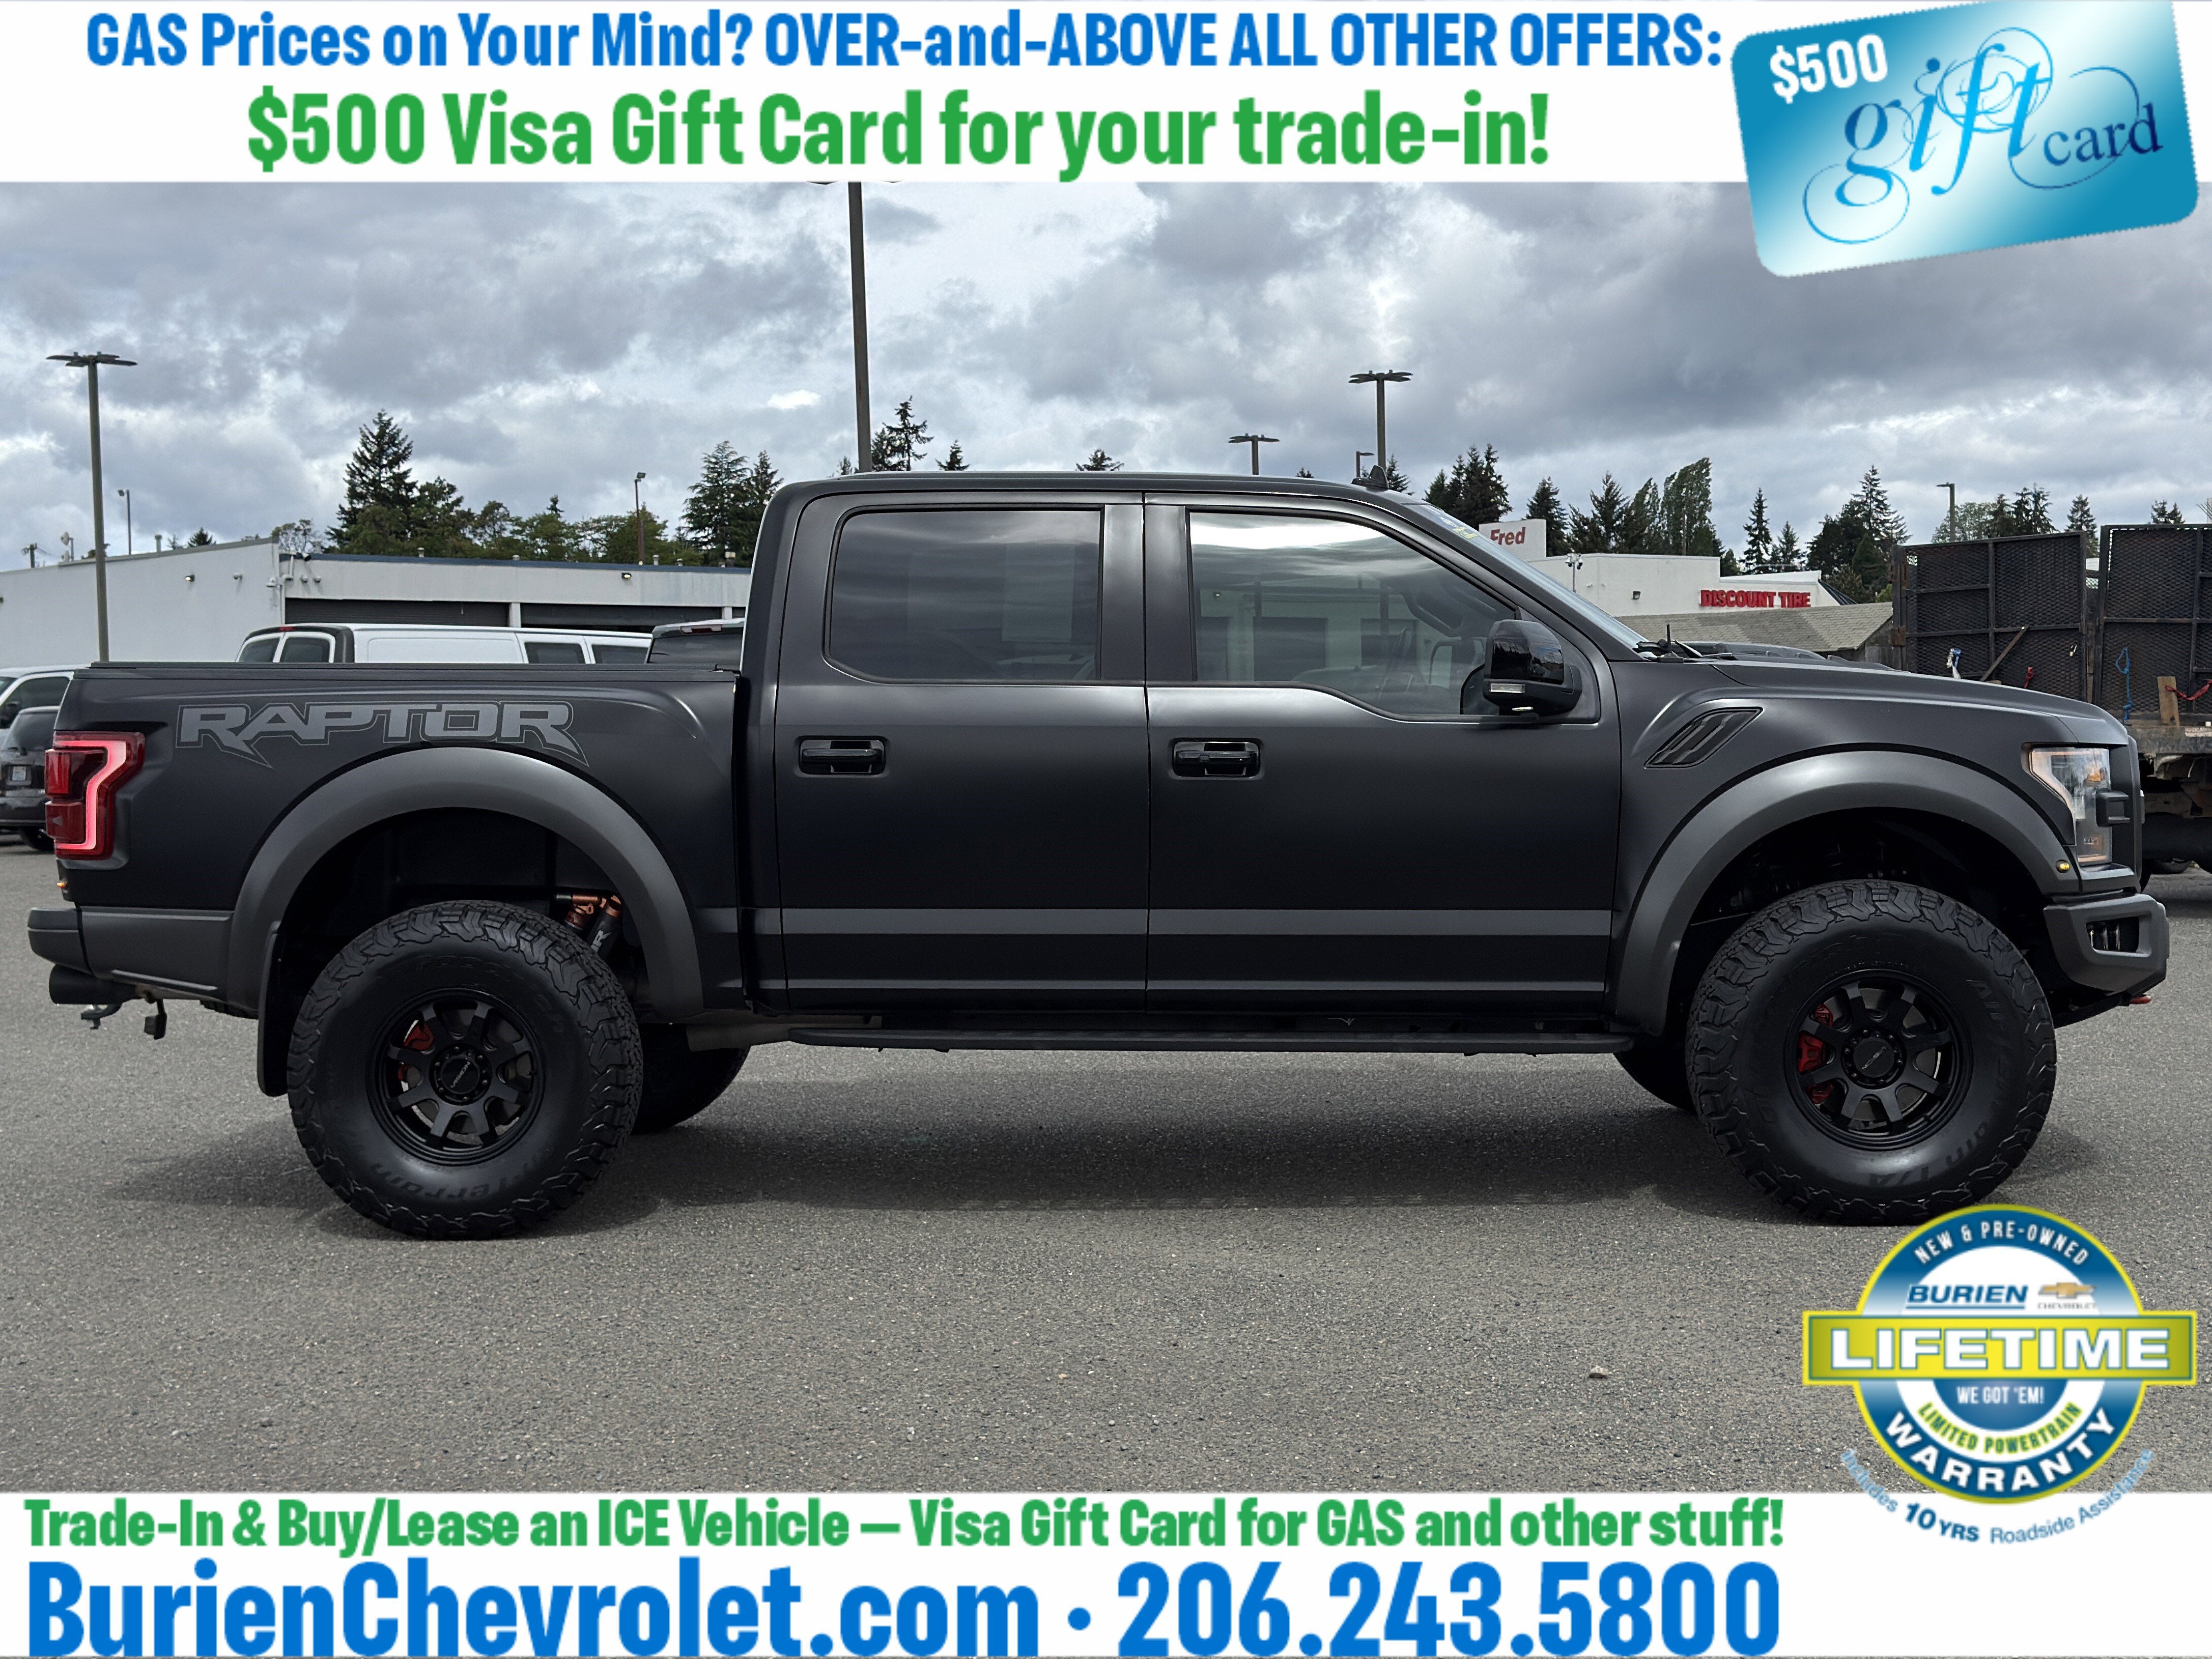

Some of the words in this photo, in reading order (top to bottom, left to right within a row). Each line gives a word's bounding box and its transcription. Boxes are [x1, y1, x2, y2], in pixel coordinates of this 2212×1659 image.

[1490, 527, 1526, 545] Fred
[1700, 589, 1776, 608] DISCOUNT
[1778, 592, 1811, 608] TIRE
[176, 701, 589, 769] RAPTOR
